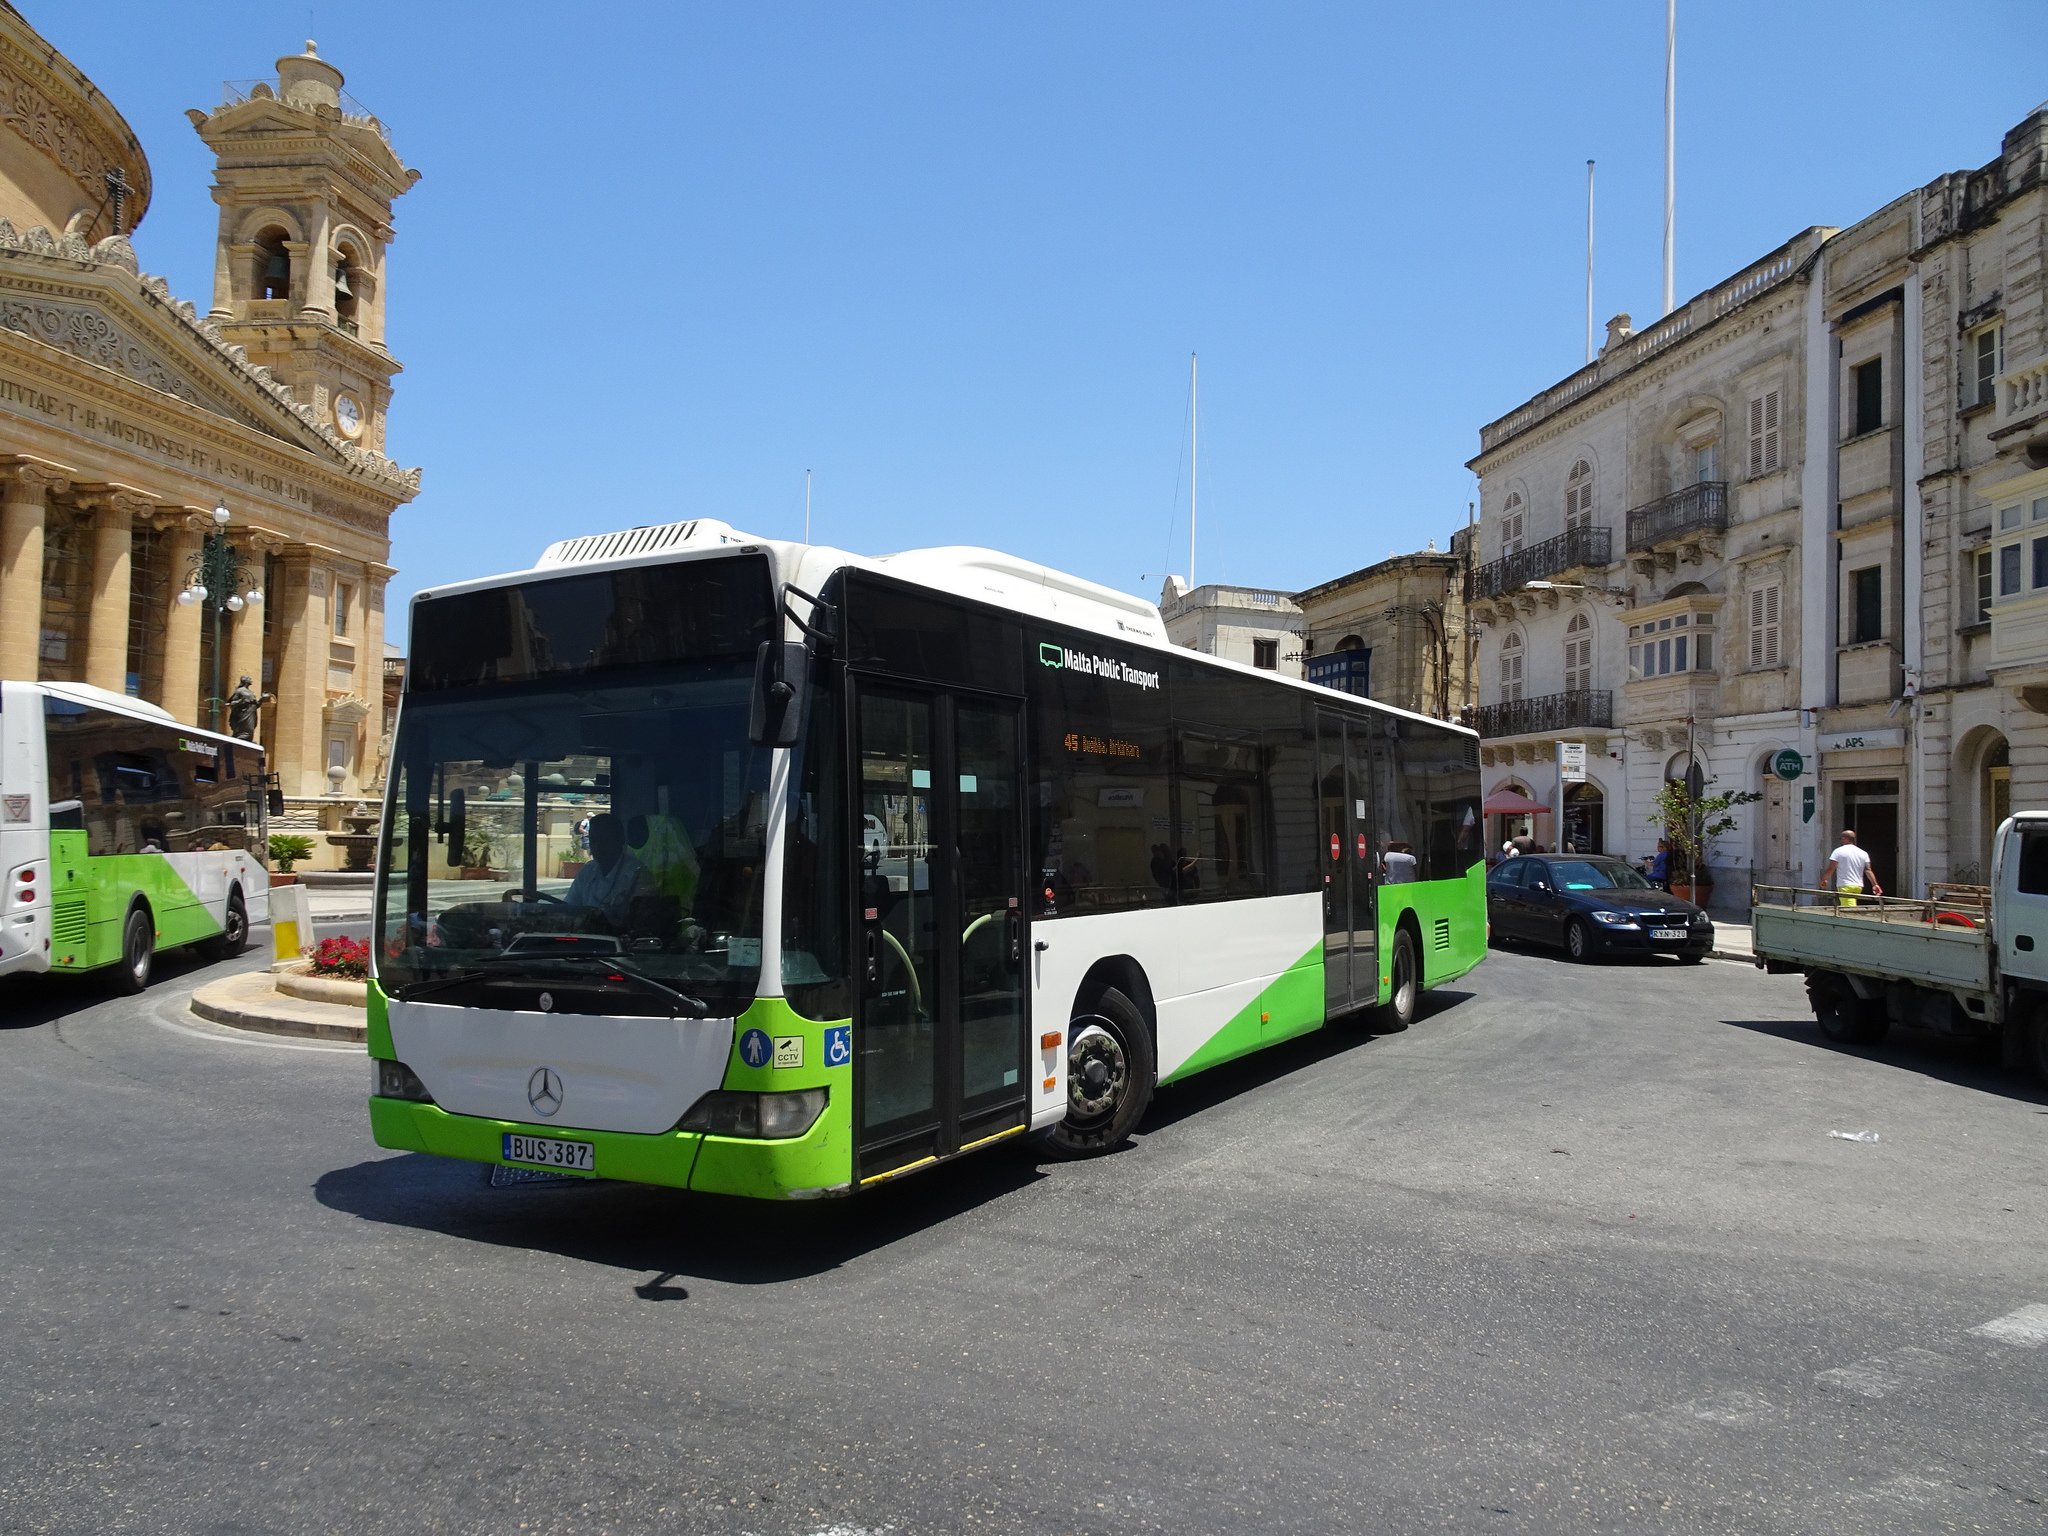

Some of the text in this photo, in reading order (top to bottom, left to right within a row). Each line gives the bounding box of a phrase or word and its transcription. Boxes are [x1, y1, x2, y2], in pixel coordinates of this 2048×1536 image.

[1064, 648, 1159, 690] Malta Public Transport
[1064, 733, 1079, 752] 45
[1845, 736, 1865, 748] APS
[1779, 762, 1801, 771] ATM
[514, 1137, 588, 1166] BUS 387
